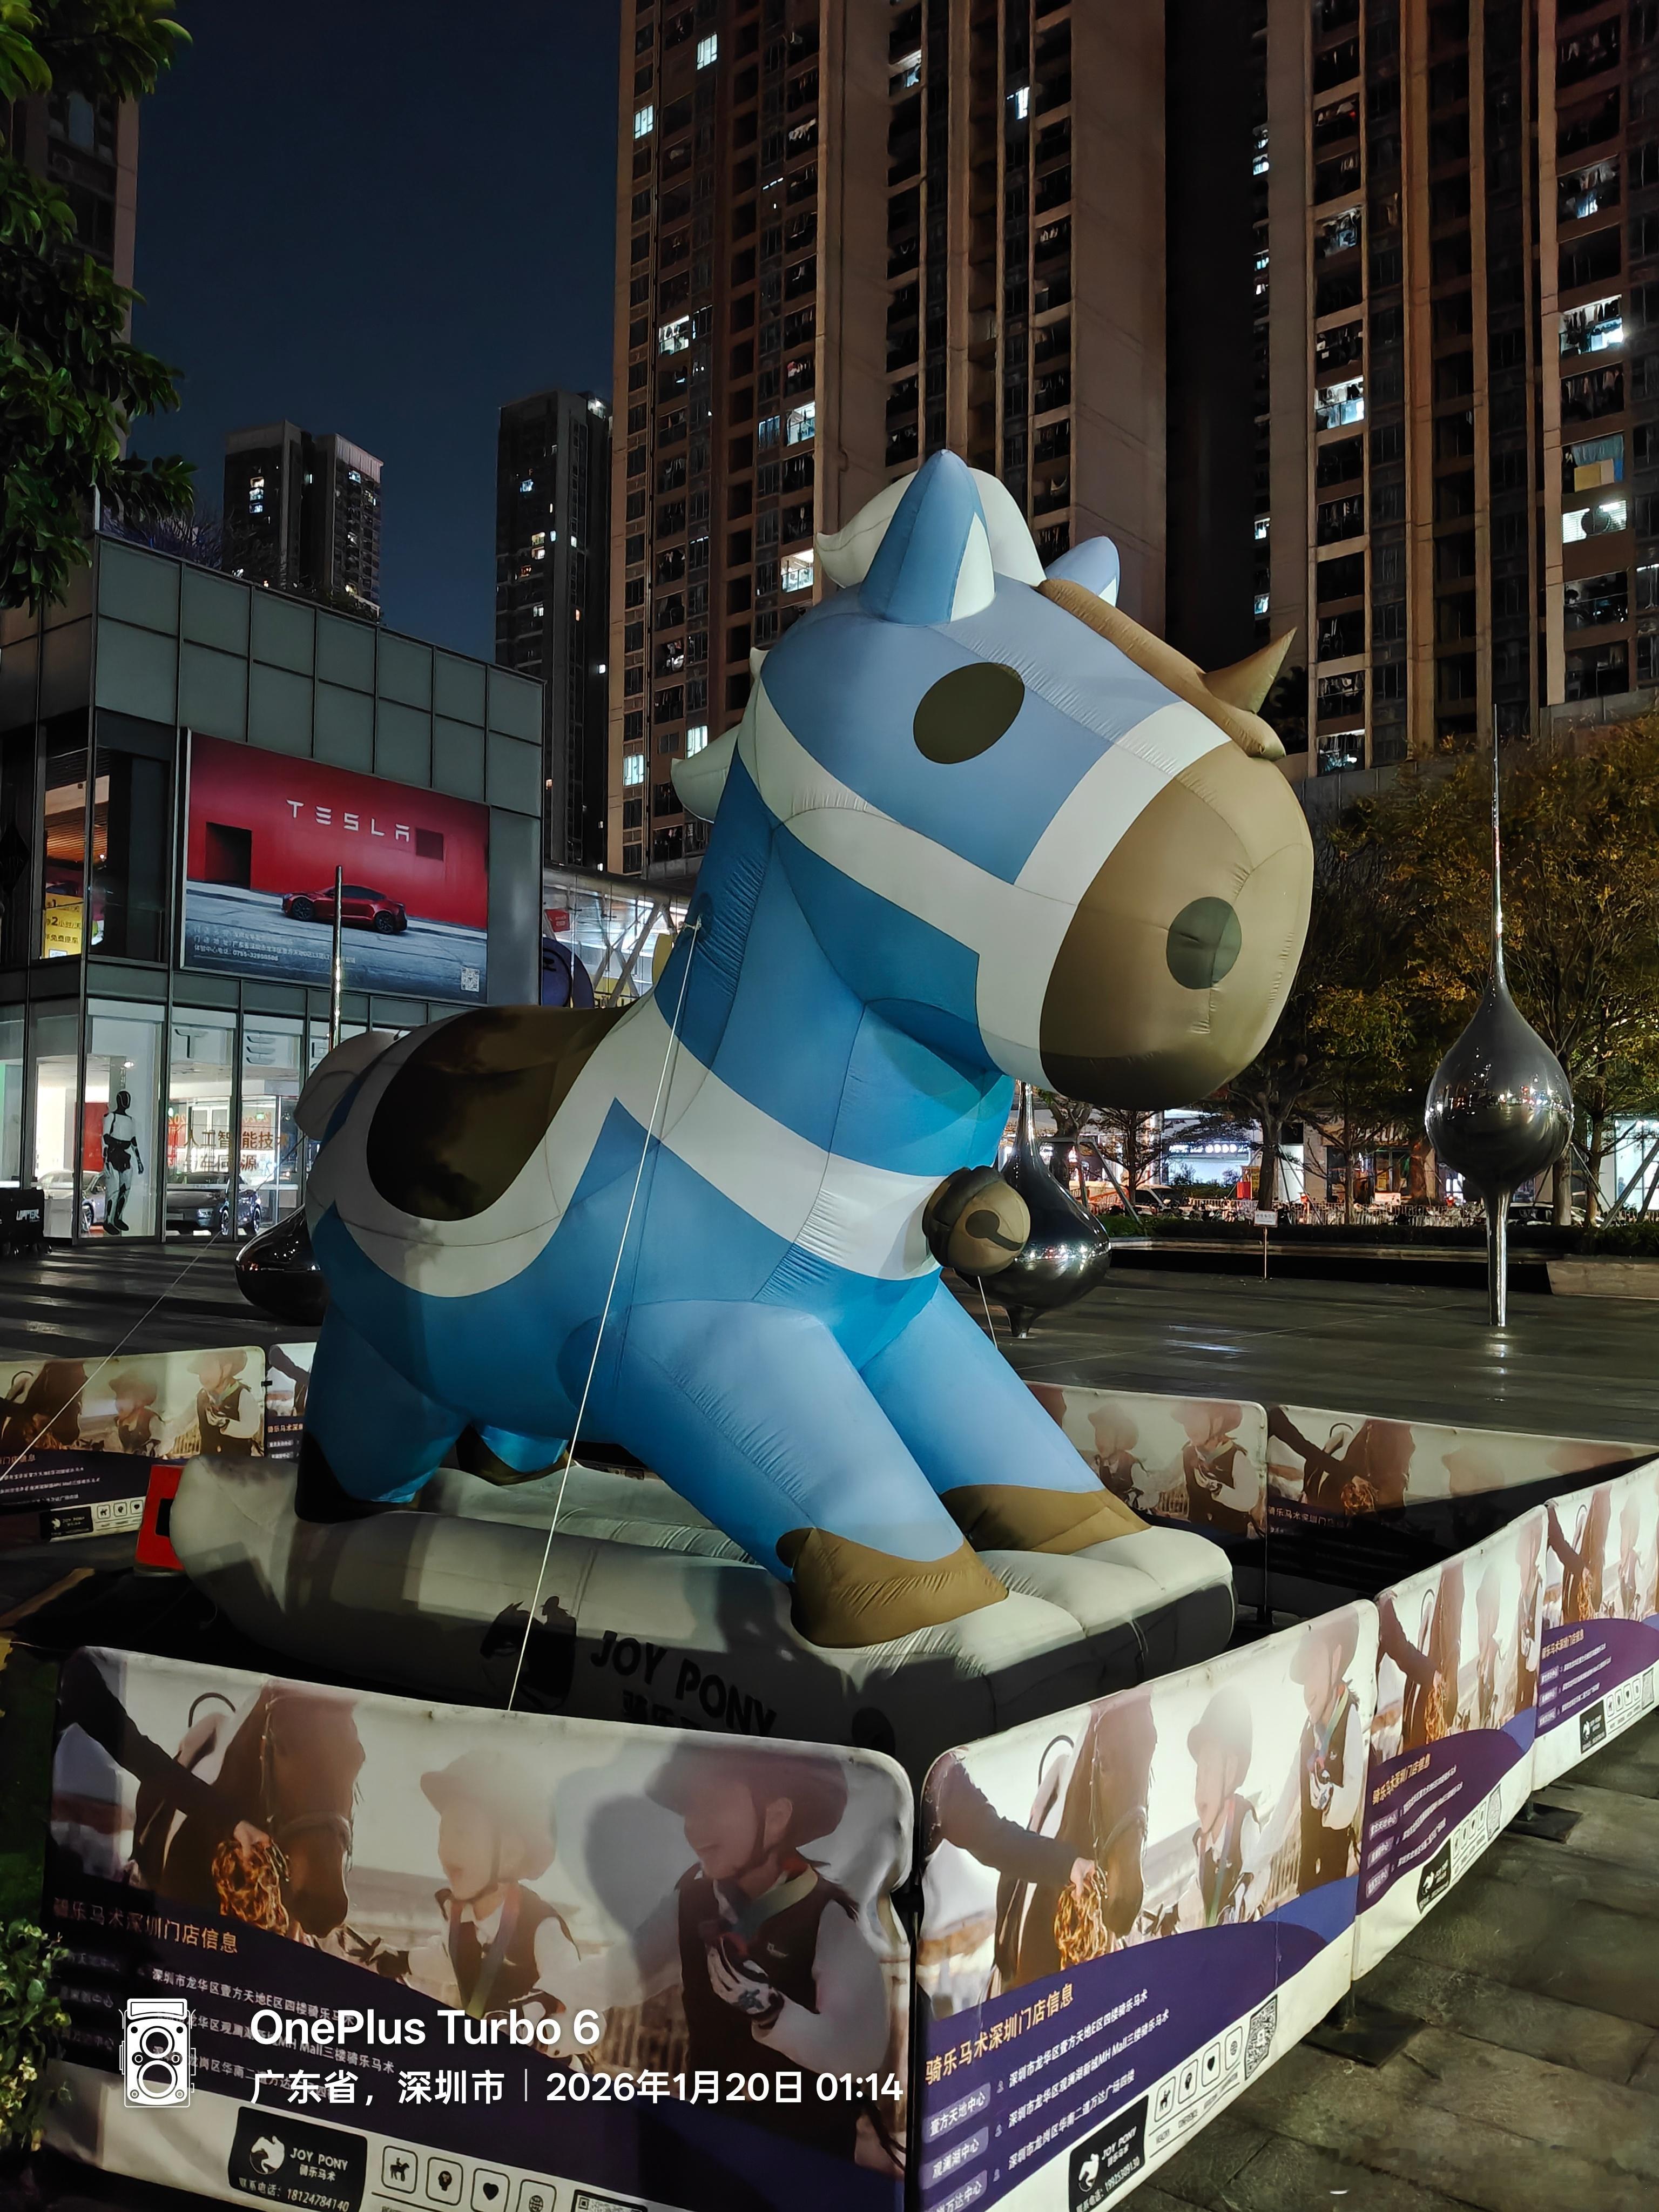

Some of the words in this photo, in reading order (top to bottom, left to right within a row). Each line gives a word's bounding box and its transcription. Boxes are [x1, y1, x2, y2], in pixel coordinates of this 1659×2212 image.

[286, 799, 410, 842] TESLA
[590, 1630, 667, 1685] JOY
[675, 1658, 777, 1736] PONY
[925, 1982, 1074, 2086] 骑乐马术深圳门店信息
[289, 2147, 314, 2163] JOY
[318, 2153, 349, 2171] PONY
